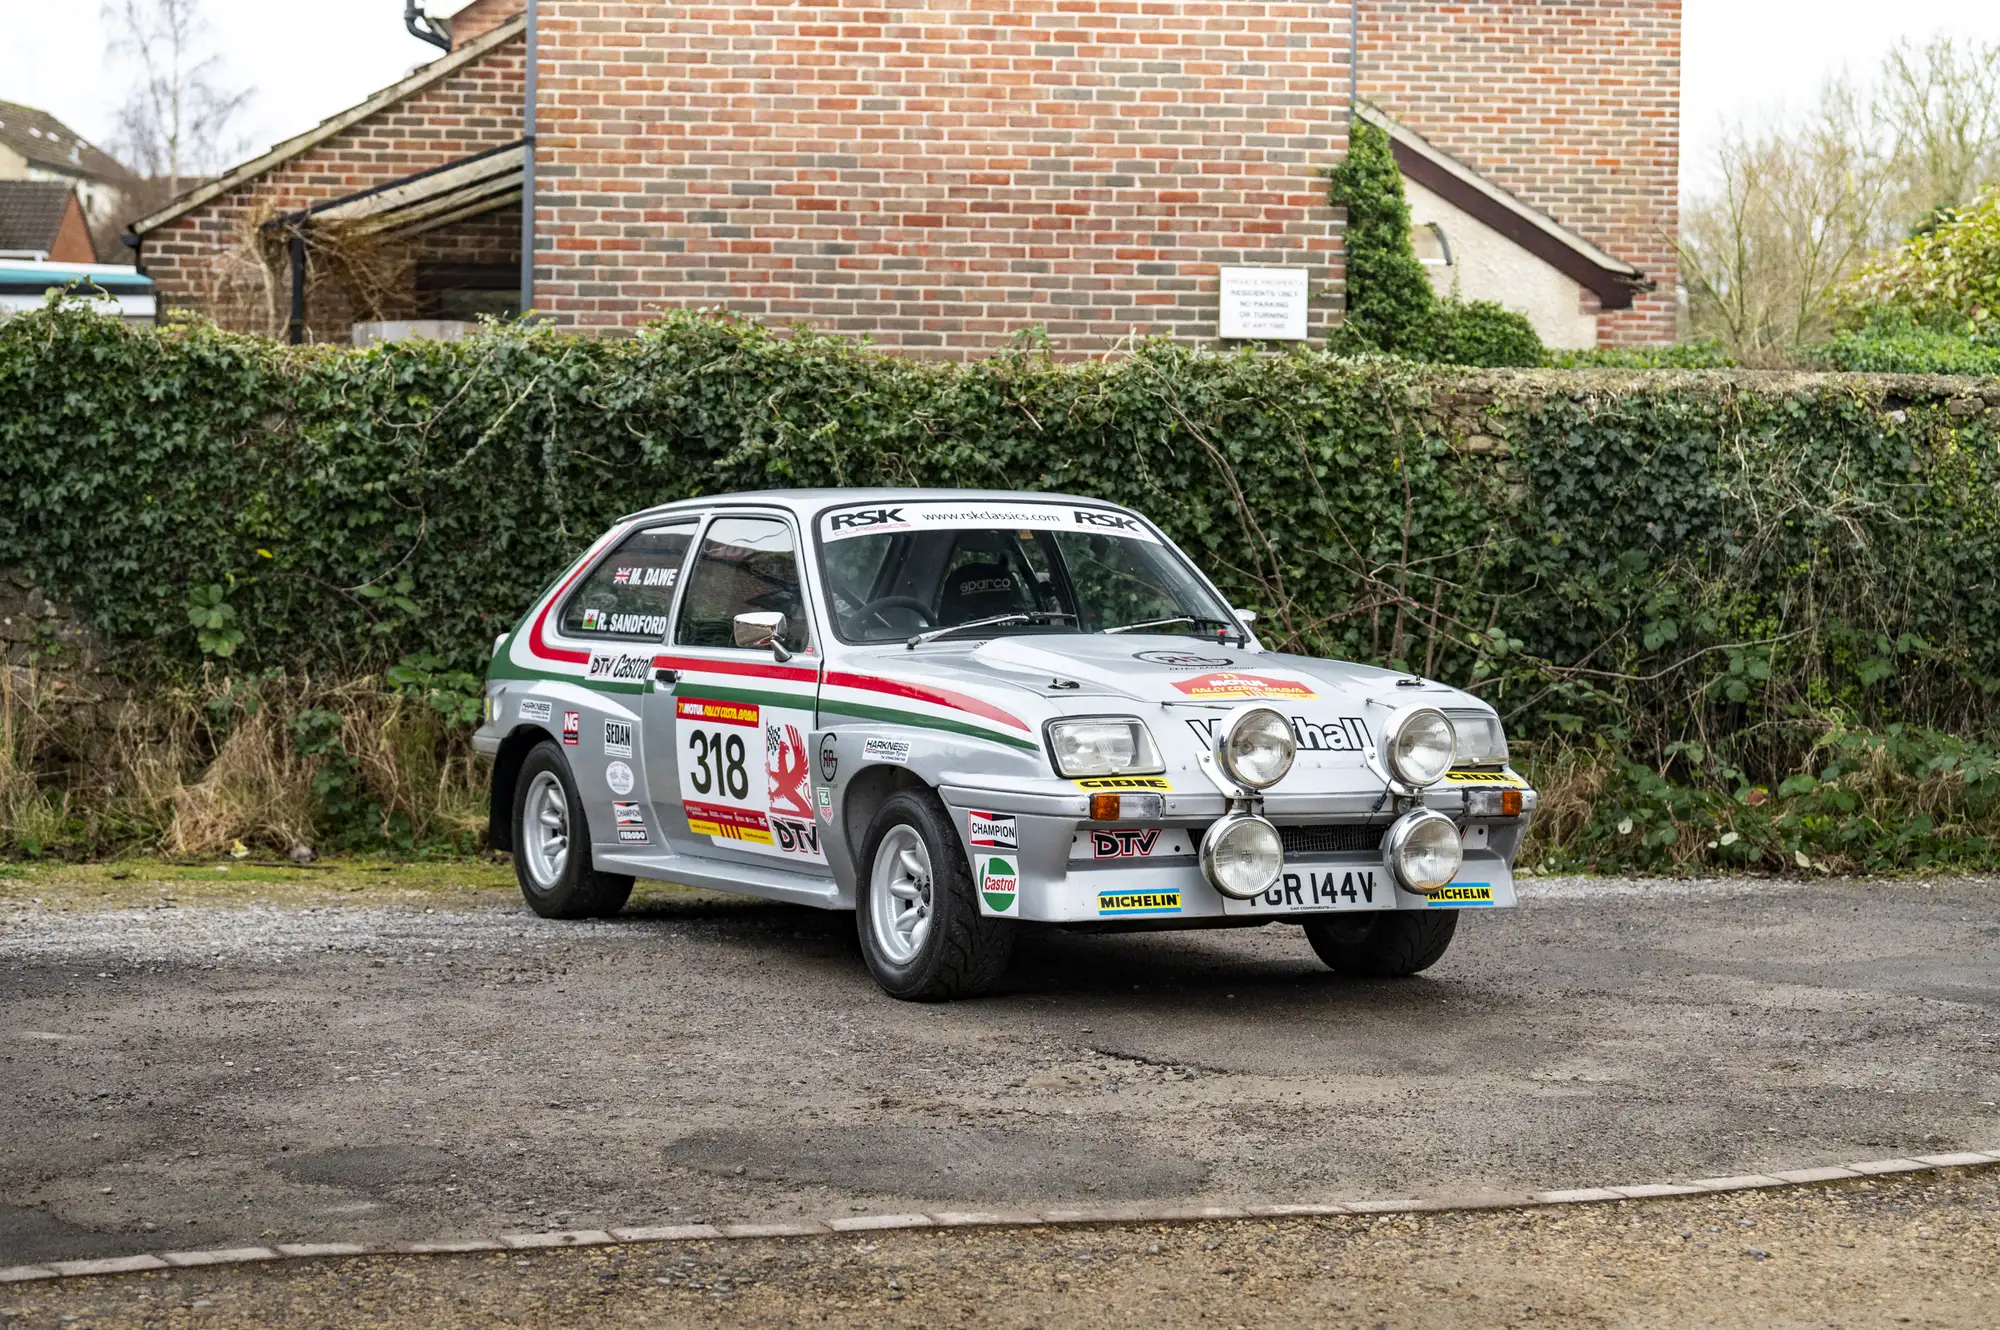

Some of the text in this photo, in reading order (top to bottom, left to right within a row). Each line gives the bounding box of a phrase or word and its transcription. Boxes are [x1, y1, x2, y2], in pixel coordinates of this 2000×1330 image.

[1230, 289, 1276, 297] RESIDENTS
[1254, 301, 1289, 309] PARKING
[831, 508, 907, 531] RSK
[922, 511, 1061, 522] www.rskclassics.com
[1074, 511, 1140, 532] RSK
[834, 522, 911, 536] CLASSICS
[629, 568, 678, 586] M. DAWE
[960, 578, 1011, 594] sparco
[597, 613, 667, 635] R. SANDFORD
[590, 655, 617, 675] DTV
[1208, 680, 1268, 688] MOTUL
[523, 701, 550, 712] HARKNESS
[684, 703, 703, 715] MOTUL
[703, 705, 720, 718] RALLY
[720, 706, 737, 719] COSTA
[738, 709, 757, 722] BRAVA
[564, 712, 578, 731] NG
[606, 723, 630, 747] SEDAN
[1185, 717, 1374, 751] Vhall
[866, 740, 909, 752] HARKNESS
[689, 729, 749, 800] 318
[1079, 780, 1168, 789] CIBIE
[620, 831, 646, 840] FERODO
[770, 817, 820, 855] DTV
[971, 822, 1015, 838] CHAMPION
[1092, 829, 1161, 858] DTV
[984, 876, 1017, 892] Castrol
[1310, 872, 1374, 905] 144V
[1101, 894, 1179, 909] MICHELIN
[1429, 888, 1490, 900] MICHELIN
